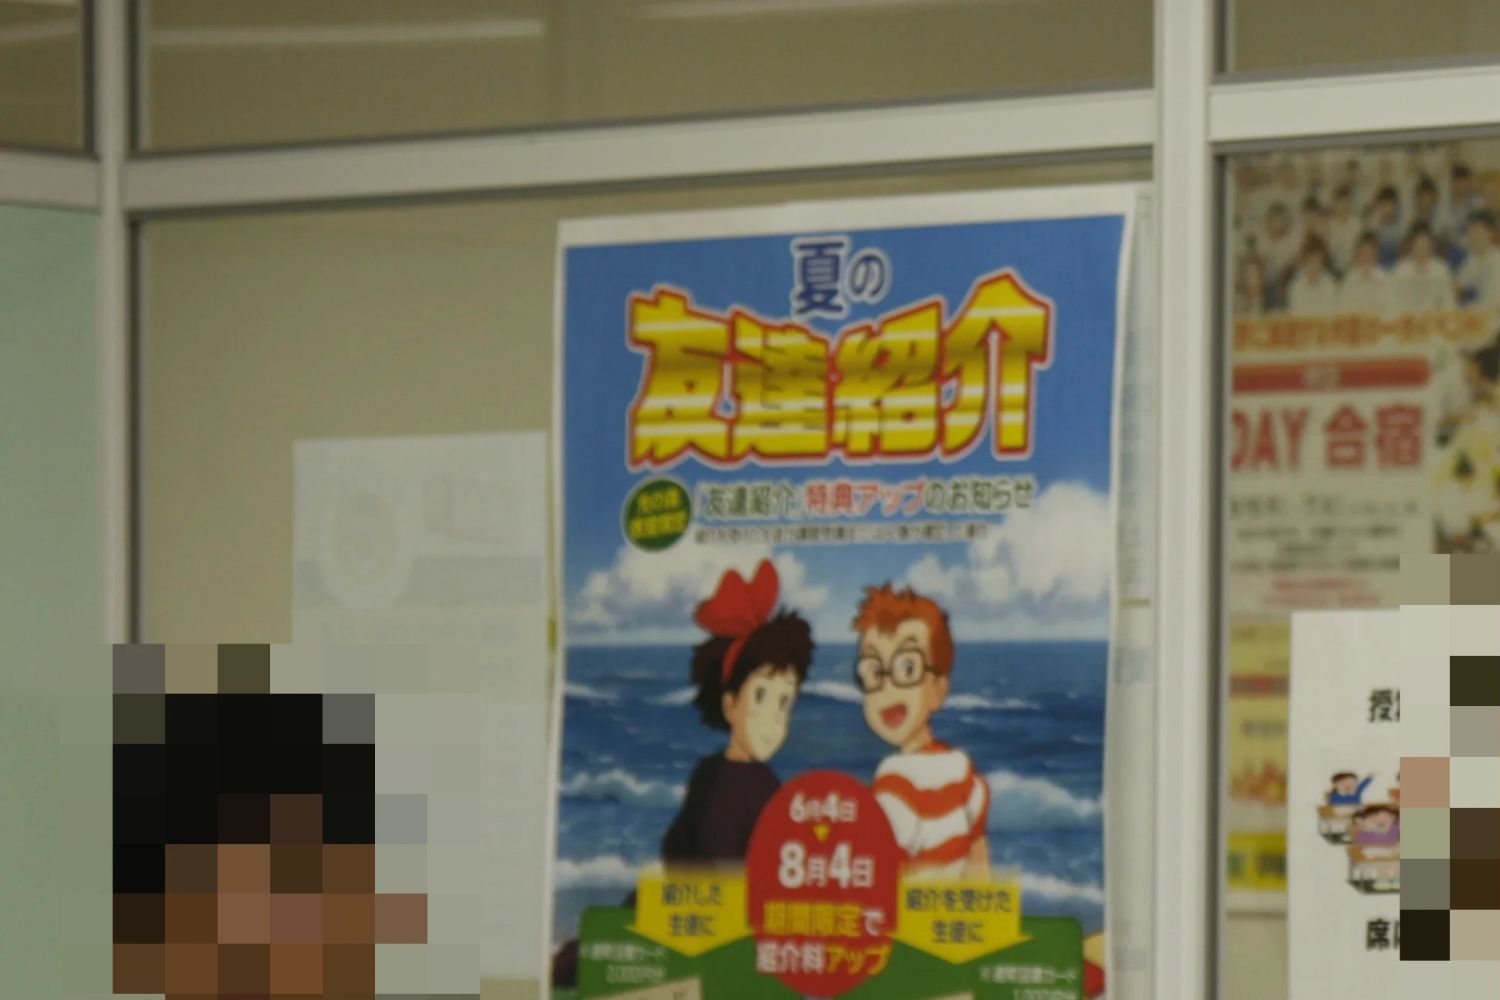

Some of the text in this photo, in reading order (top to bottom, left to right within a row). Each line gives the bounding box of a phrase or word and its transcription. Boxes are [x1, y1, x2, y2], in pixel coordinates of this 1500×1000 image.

[795, 241, 885, 314] 夏の
[630, 272, 1050, 465] 友達紹介
[1369, 689, 1400, 722] 授
[789, 793, 858, 823] 6月4日
[779, 843, 875, 888] 8月4日
[763, 901, 884, 937] 期間限定で
[1367, 917, 1400, 950] 席
[756, 941, 891, 975] 紹介料アップ
